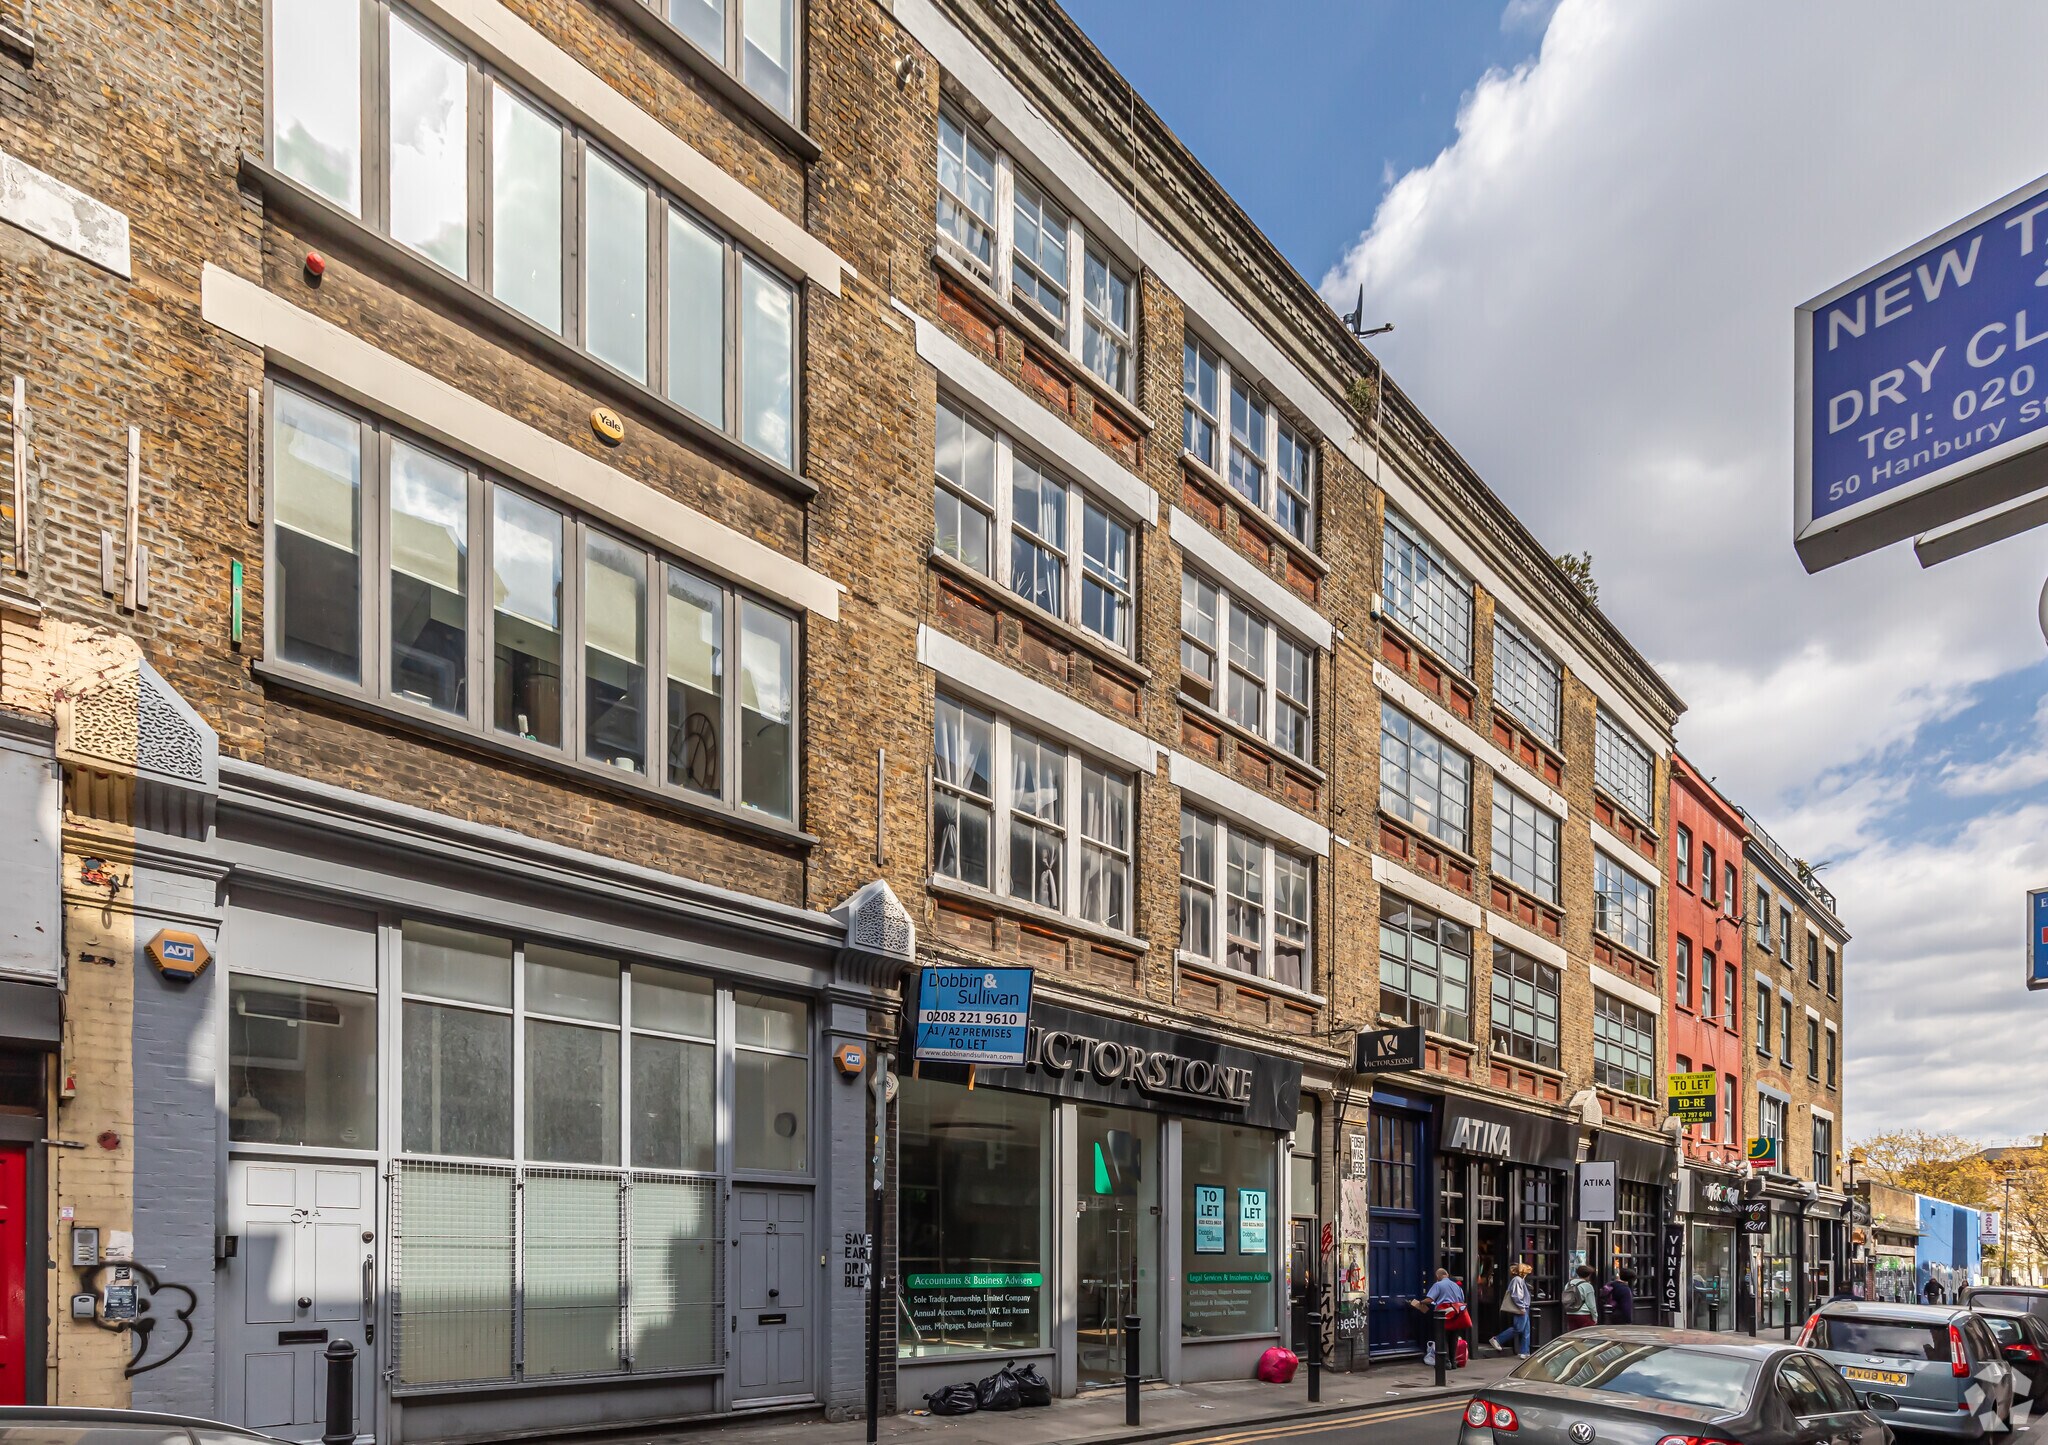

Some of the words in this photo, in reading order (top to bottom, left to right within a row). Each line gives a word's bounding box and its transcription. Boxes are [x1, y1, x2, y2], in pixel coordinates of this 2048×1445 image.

[1828, 234, 1983, 351] NEW
[2004, 201, 2048, 257] T
[1828, 346, 1947, 434] DRY
[1858, 412, 1934, 459] Tel:
[1952, 365, 2035, 421] 020
[599, 412, 621, 432] Yale
[1829, 474, 1860, 501] 50
[1872, 416, 2006, 485] Hanbury
[164, 945, 194, 958] ADT
[957, 989, 1019, 1006] Sullivan
[926, 1011, 956, 1023] 0208
[958, 1012, 982, 1024] 221
[985, 1013, 1018, 1025] 9610
[948, 1026, 960, 1036] A2
[962, 1027, 1012, 1039] PREMISES
[949, 1037, 964, 1049] TO
[967, 1038, 988, 1050] LET
[846, 1054, 860, 1063] ADT
[925, 1049, 1014, 1060] www.dobbinandsullivan.com
[1027, 1025, 1253, 1107] ICTORSTONE
[1674, 1080, 1687, 1091] TO
[1691, 1079, 1710, 1090] LET
[1678, 1098, 1706, 1108] TD-RE
[1451, 1117, 1511, 1157] ATIKA
[1583, 1178, 1612, 1187] ATIKA
[1202, 1190, 1217, 1202] TO
[1246, 1193, 1260, 1206] TO
[1201, 1205, 1219, 1217] LET
[1244, 1208, 1261, 1219] LET
[845, 1233, 872, 1246] SAVE
[845, 1247, 873, 1260] EART
[845, 1262, 872, 1275] DRIN
[1666, 1235, 1679, 1309] VINTAGE
[845, 1276, 886, 1290] BLEAH
[914, 1276, 962, 1285] Accountants
[964, 1276, 971, 1285] &
[973, 1275, 1003, 1285] Business
[1004, 1275, 1033, 1285] Advisers
[914, 1295, 927, 1304] Sole
[929, 1294, 949, 1304] Trader,
[950, 1294, 983, 1304] Partnership,
[983, 1293, 1003, 1302] Limited
[1005, 1293, 1030, 1303] Company
[914, 1309, 936, 1318] Annual
[938, 1308, 966, 1317] Accounts,
[1002, 1307, 1011, 1315] Tax
[915, 1322, 933, 1332] oans,
[967, 1320, 990, 1330] Business
[992, 1319, 1013, 1328] Finance
[1847, 1369, 1878, 1380] MV08
[1882, 1373, 1906, 1383] VLX
